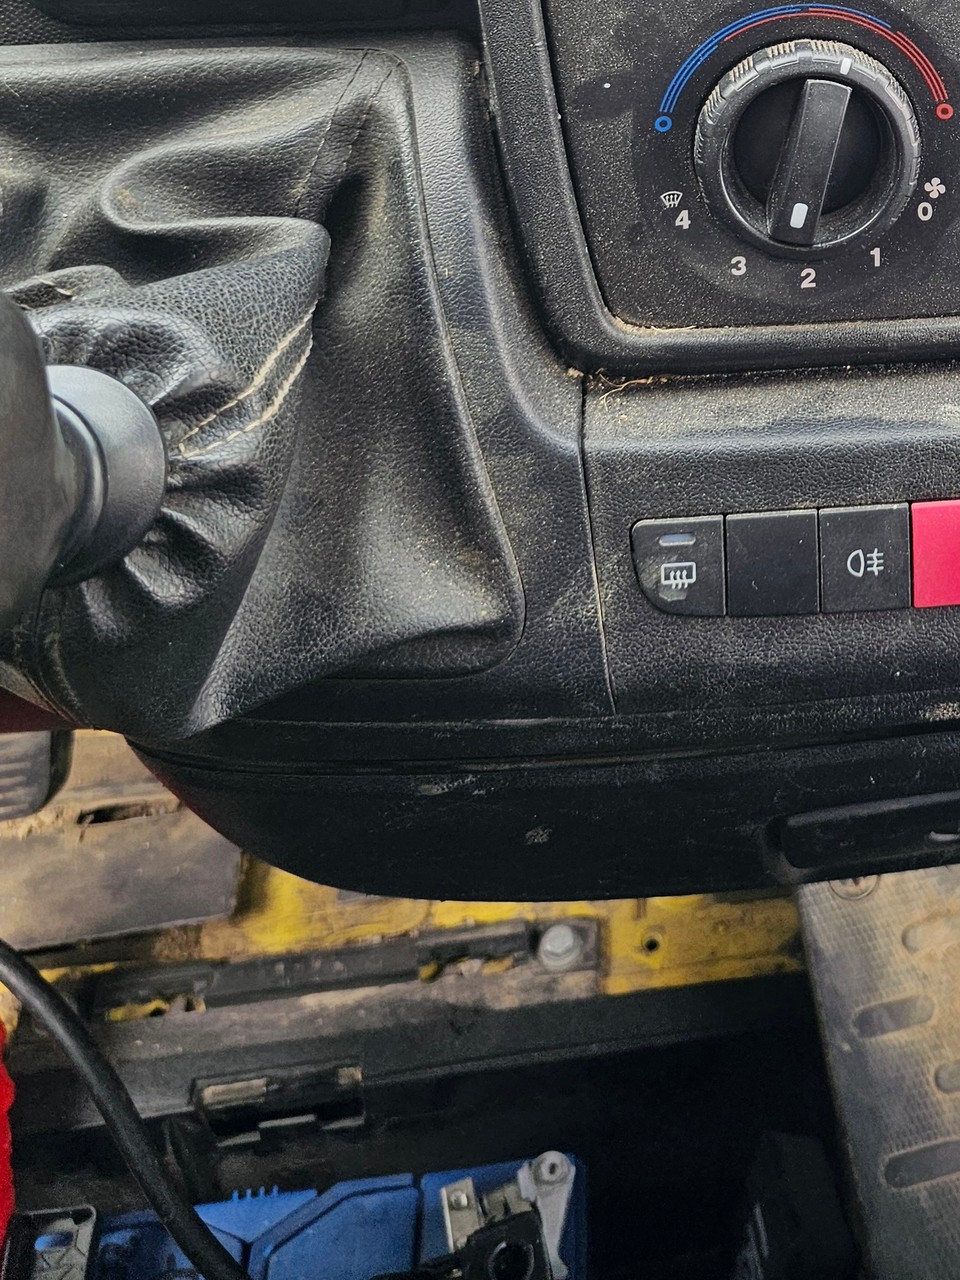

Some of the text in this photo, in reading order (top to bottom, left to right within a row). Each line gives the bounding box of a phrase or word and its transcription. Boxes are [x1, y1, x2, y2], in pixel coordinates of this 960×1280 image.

[674, 209, 691, 228] 4
[917, 201, 933, 221] 0
[730, 256, 748, 276] 3
[869, 248, 881, 267] 1
[800, 268, 817, 288] 2
